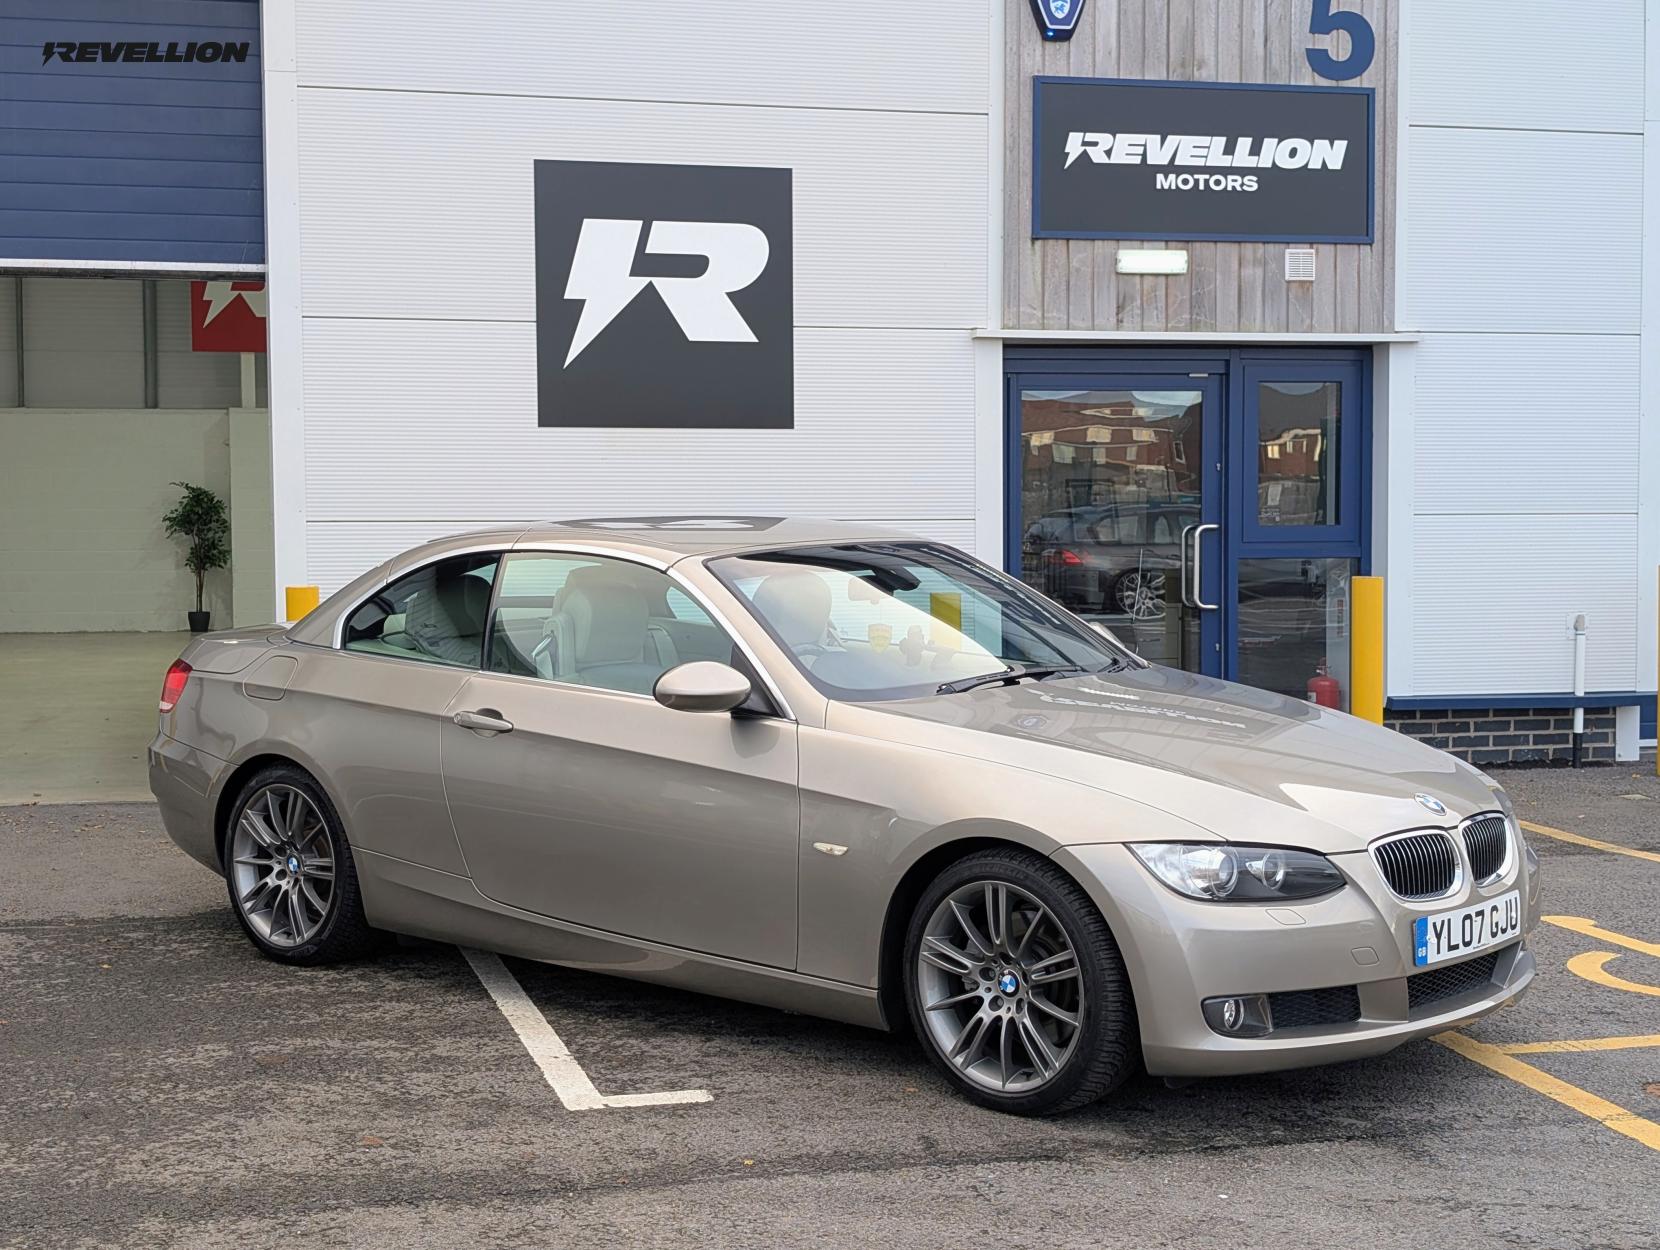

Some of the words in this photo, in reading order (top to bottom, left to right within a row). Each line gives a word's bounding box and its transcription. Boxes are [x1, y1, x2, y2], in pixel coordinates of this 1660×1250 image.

[1305, 0, 1375, 82] 5
[1064, 132, 1348, 170] REVELLION
[1156, 173, 1259, 192] MOTORS
[563, 218, 769, 369] R
[1432, 909, 1485, 955] YL07
[1490, 897, 1518, 938] GJU
